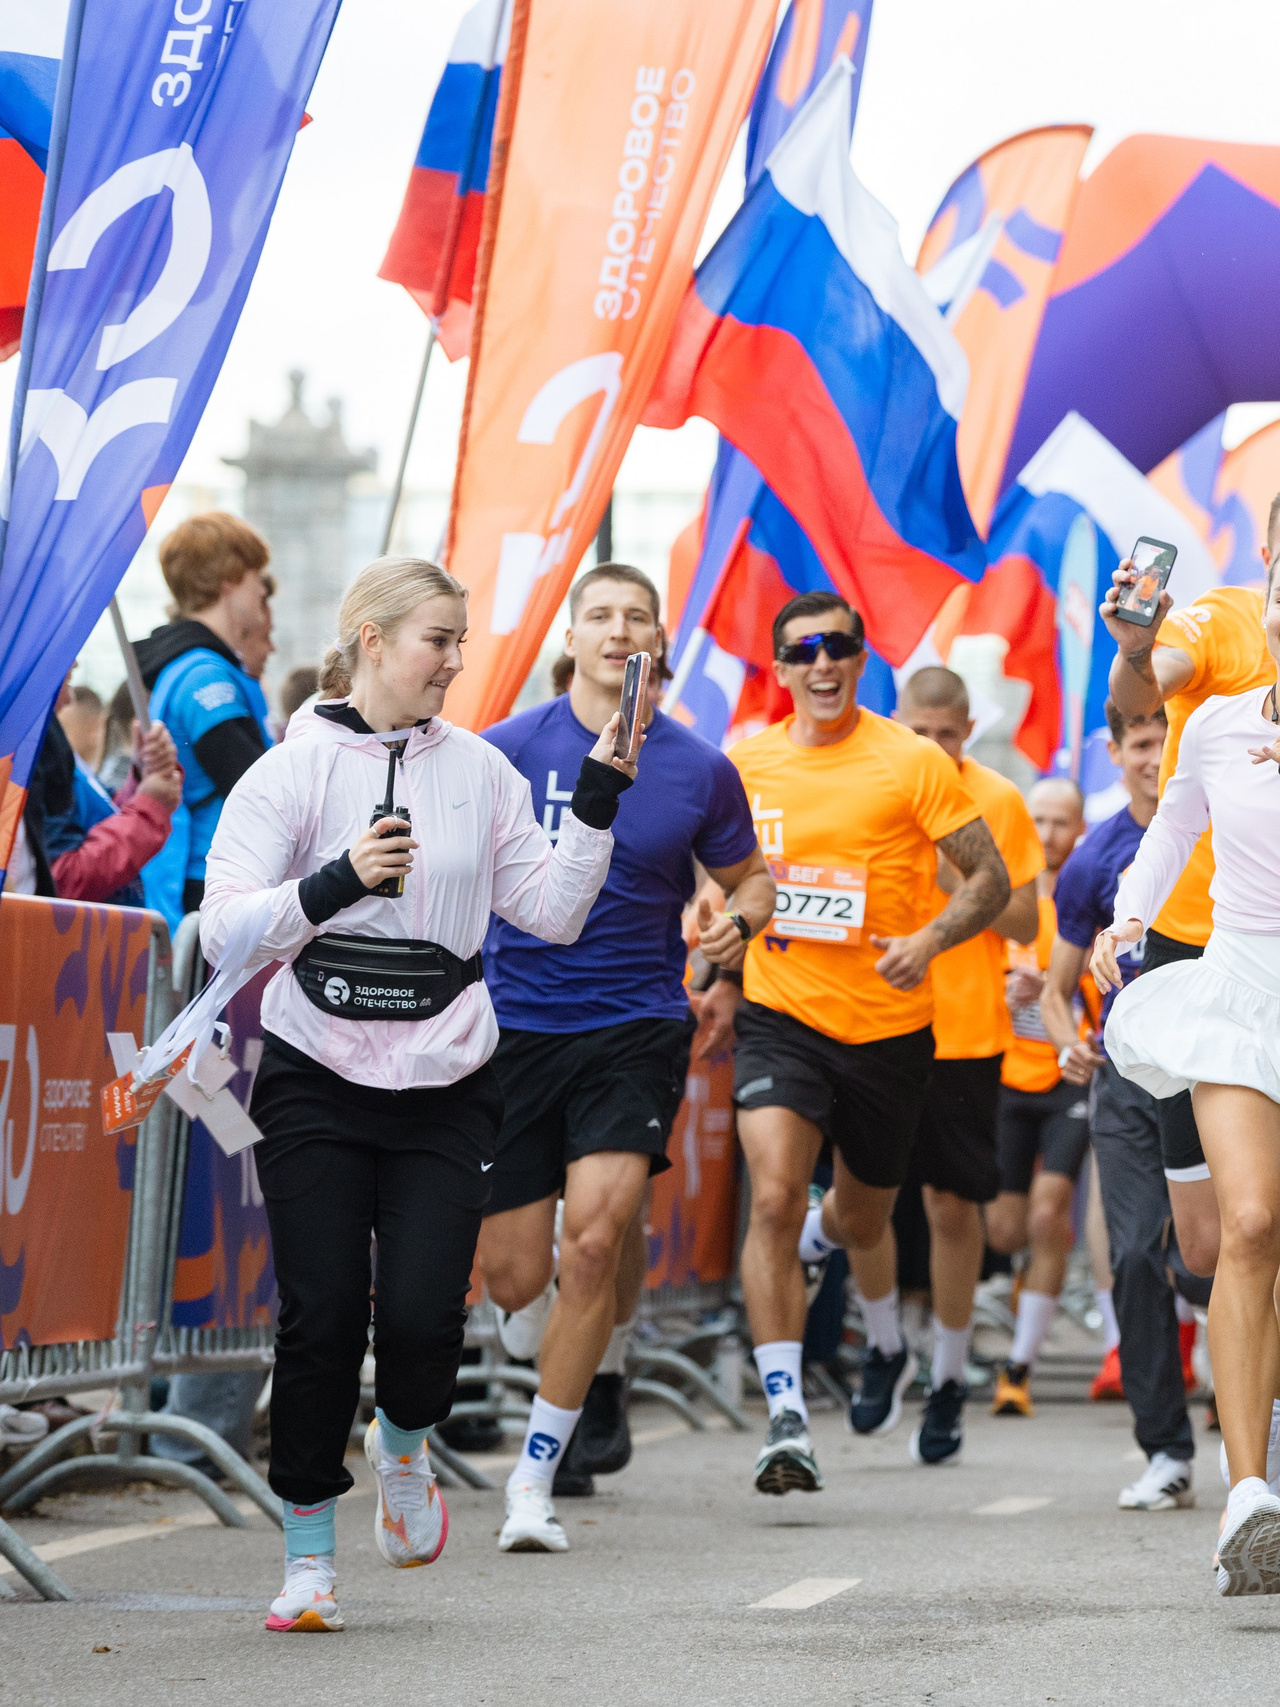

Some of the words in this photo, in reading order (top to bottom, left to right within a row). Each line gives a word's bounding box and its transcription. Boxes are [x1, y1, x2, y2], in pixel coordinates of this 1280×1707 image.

[594, 66, 666, 320] ЗДОРОВОЕ
[776, 892, 853, 919] 0772
[355, 986, 415, 998] ЗДОРОВОЕ
[354, 997, 417, 1009] ОТЕЧЕСТВО
